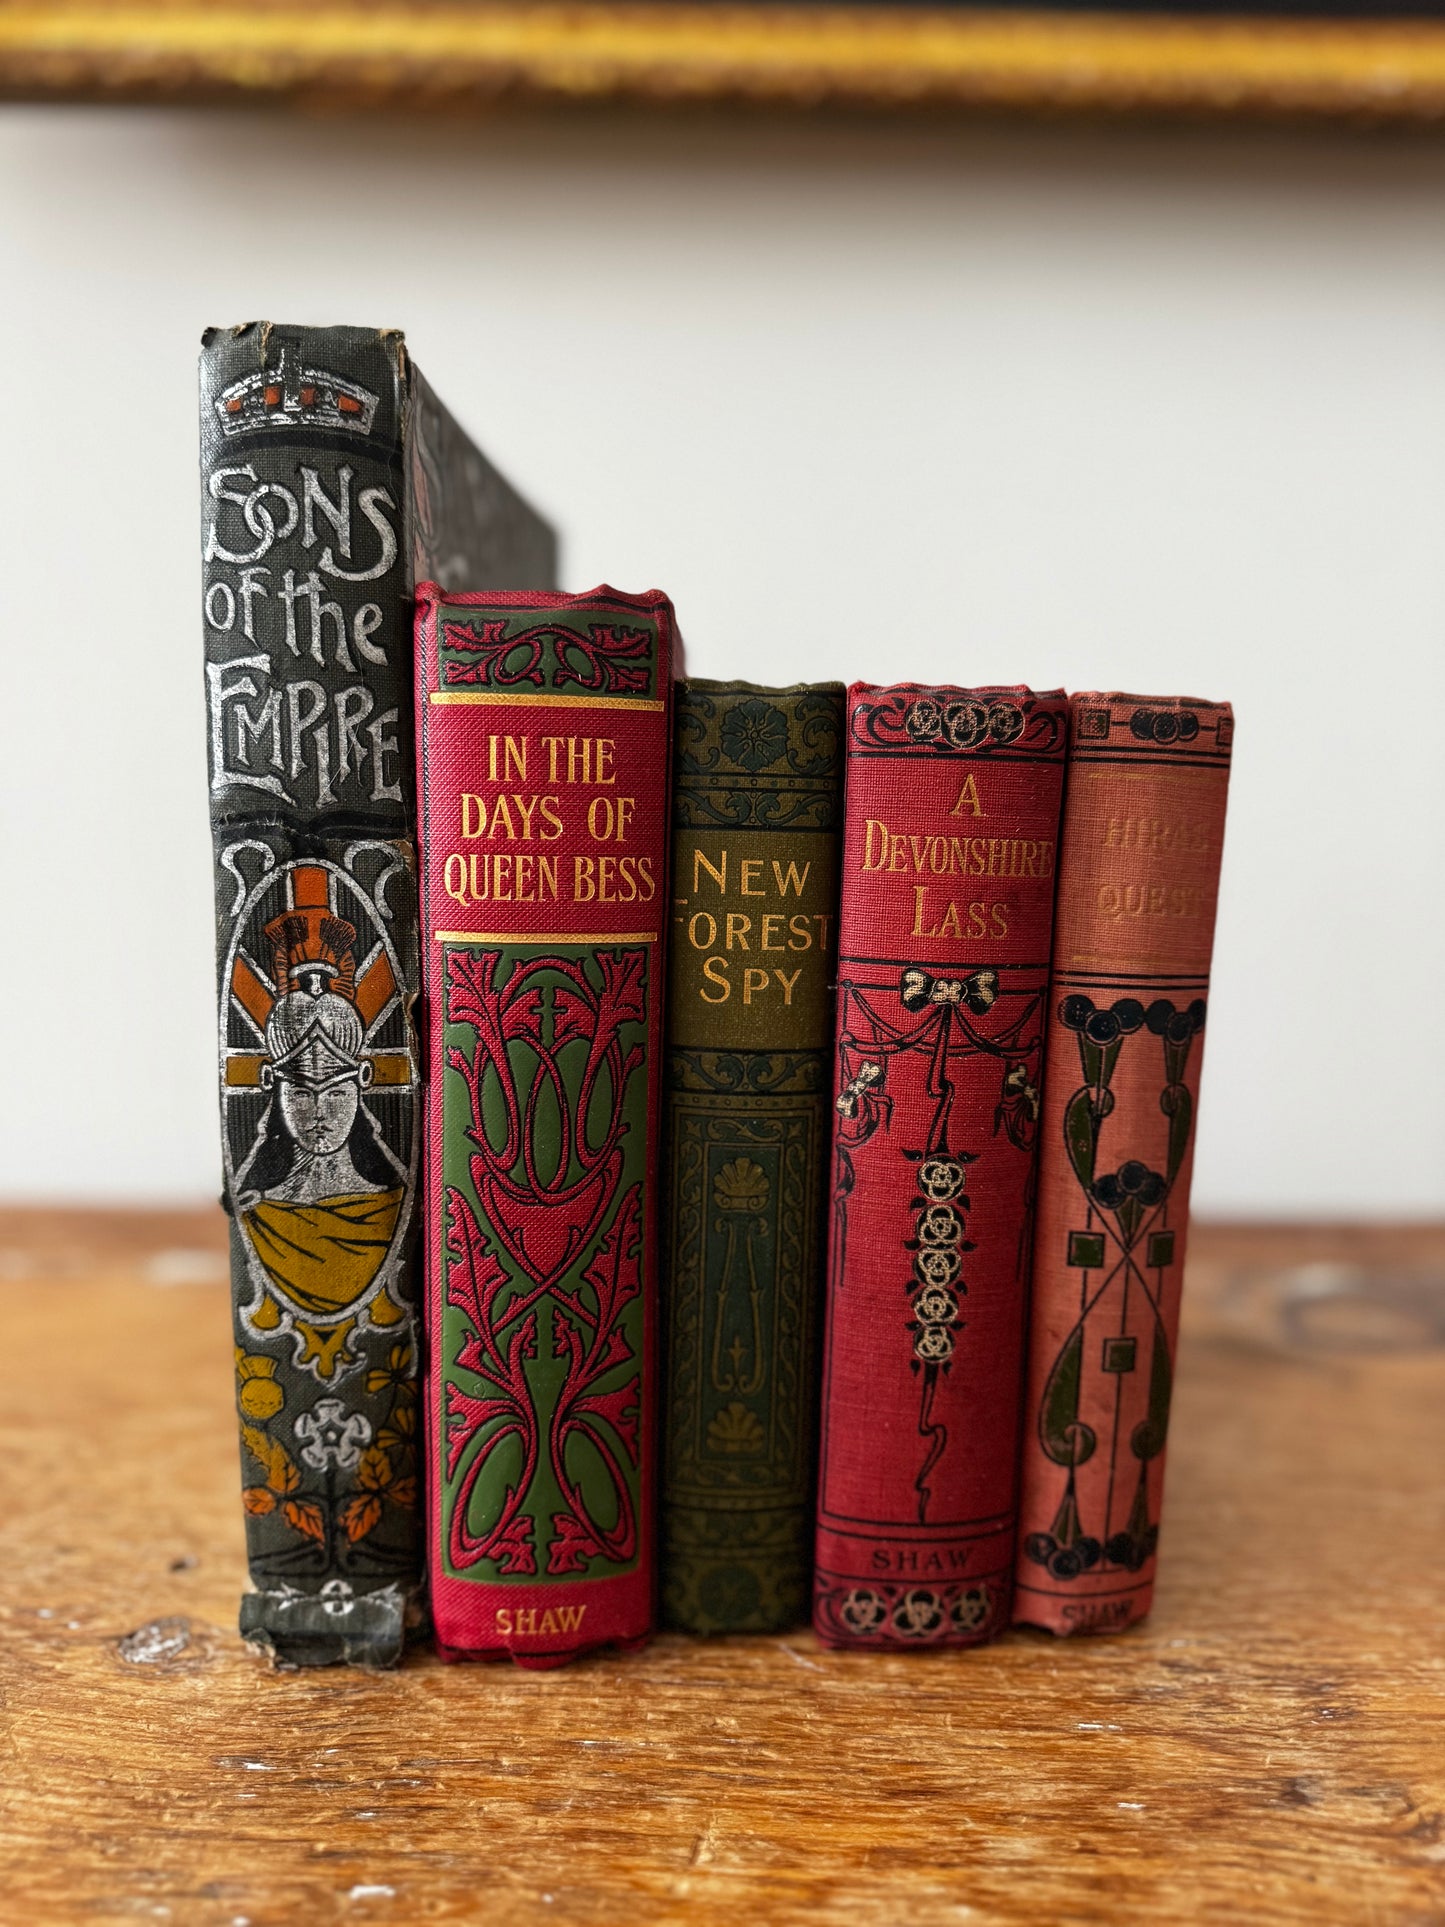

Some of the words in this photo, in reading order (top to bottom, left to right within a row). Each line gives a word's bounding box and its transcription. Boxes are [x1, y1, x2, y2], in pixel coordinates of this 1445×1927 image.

[204, 463, 398, 582] SONS
[205, 653, 403, 807] EMPIRE
[487, 735, 528, 782] IN
[541, 736, 617, 785] THE
[461, 793, 564, 840] DAYS
[587, 796, 636, 842] OF
[950, 773, 989, 817] A
[693, 849, 811, 897] NEW
[862, 819, 1054, 878] DEVONSHIRE
[443, 853, 559, 907] QUEEN
[573, 856, 656, 903] BESS
[911, 885, 1010, 940] LASS
[700, 955, 803, 1006] SPY
[871, 1547, 973, 1571] SHAW
[495, 1604, 587, 1635] SHAW
